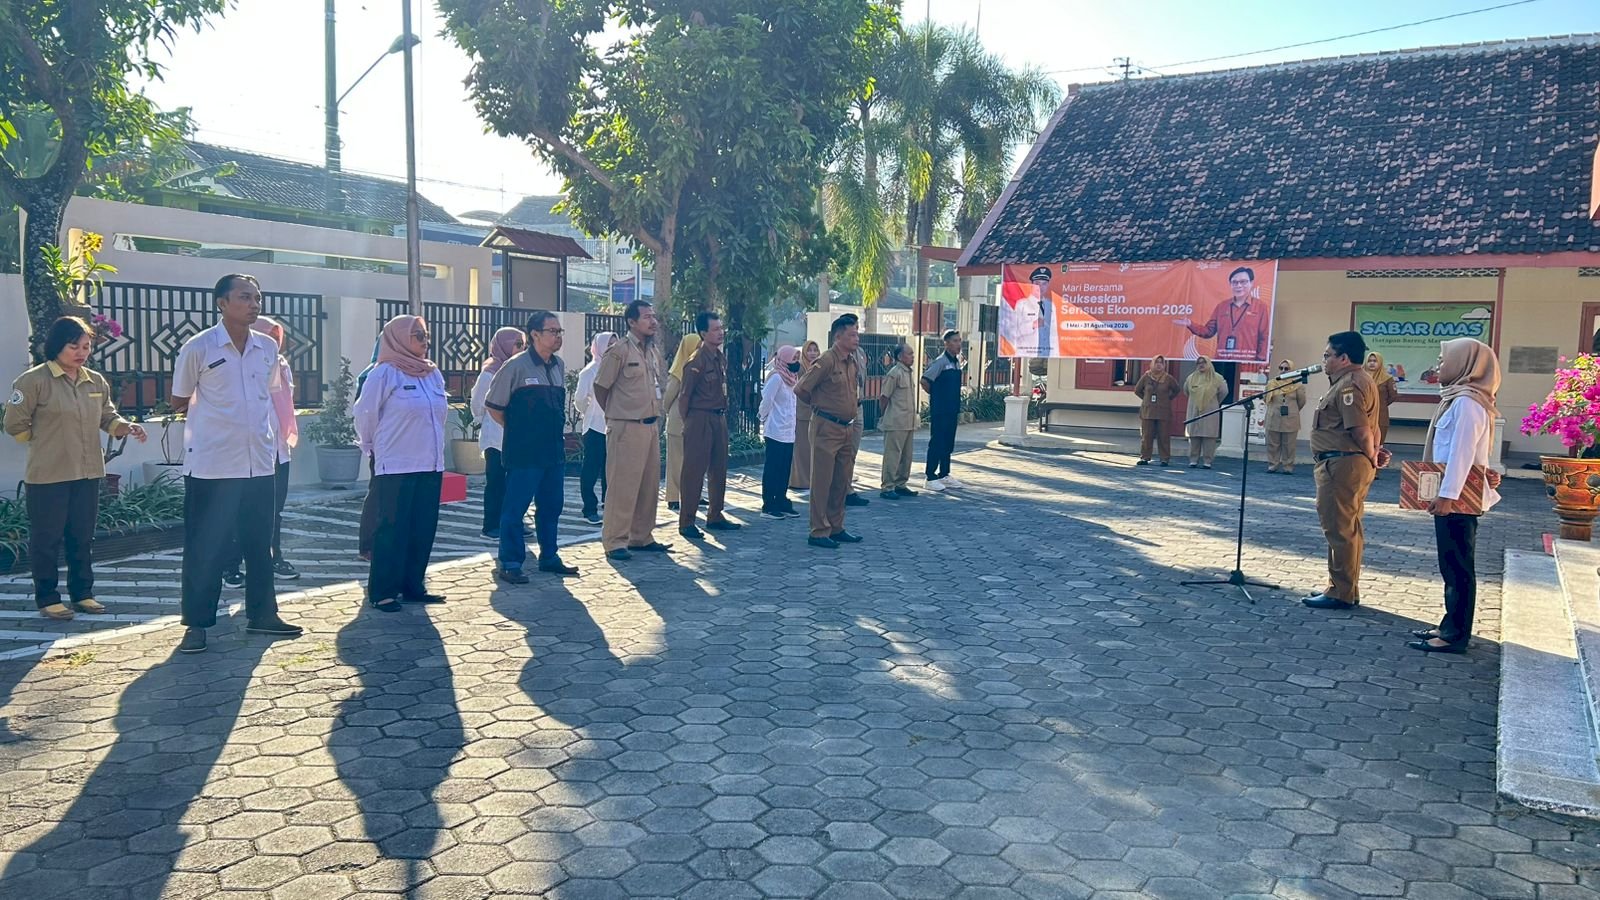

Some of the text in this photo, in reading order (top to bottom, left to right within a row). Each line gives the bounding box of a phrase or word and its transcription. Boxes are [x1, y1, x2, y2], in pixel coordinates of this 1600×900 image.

[1062, 284, 1124, 292] Mari Bersama
[1062, 294, 1126, 304] Sukseskan
[1061, 304, 1193, 316] Sensus Ekonomi 2026
[1361, 320, 1484, 336] SABAR MAS
